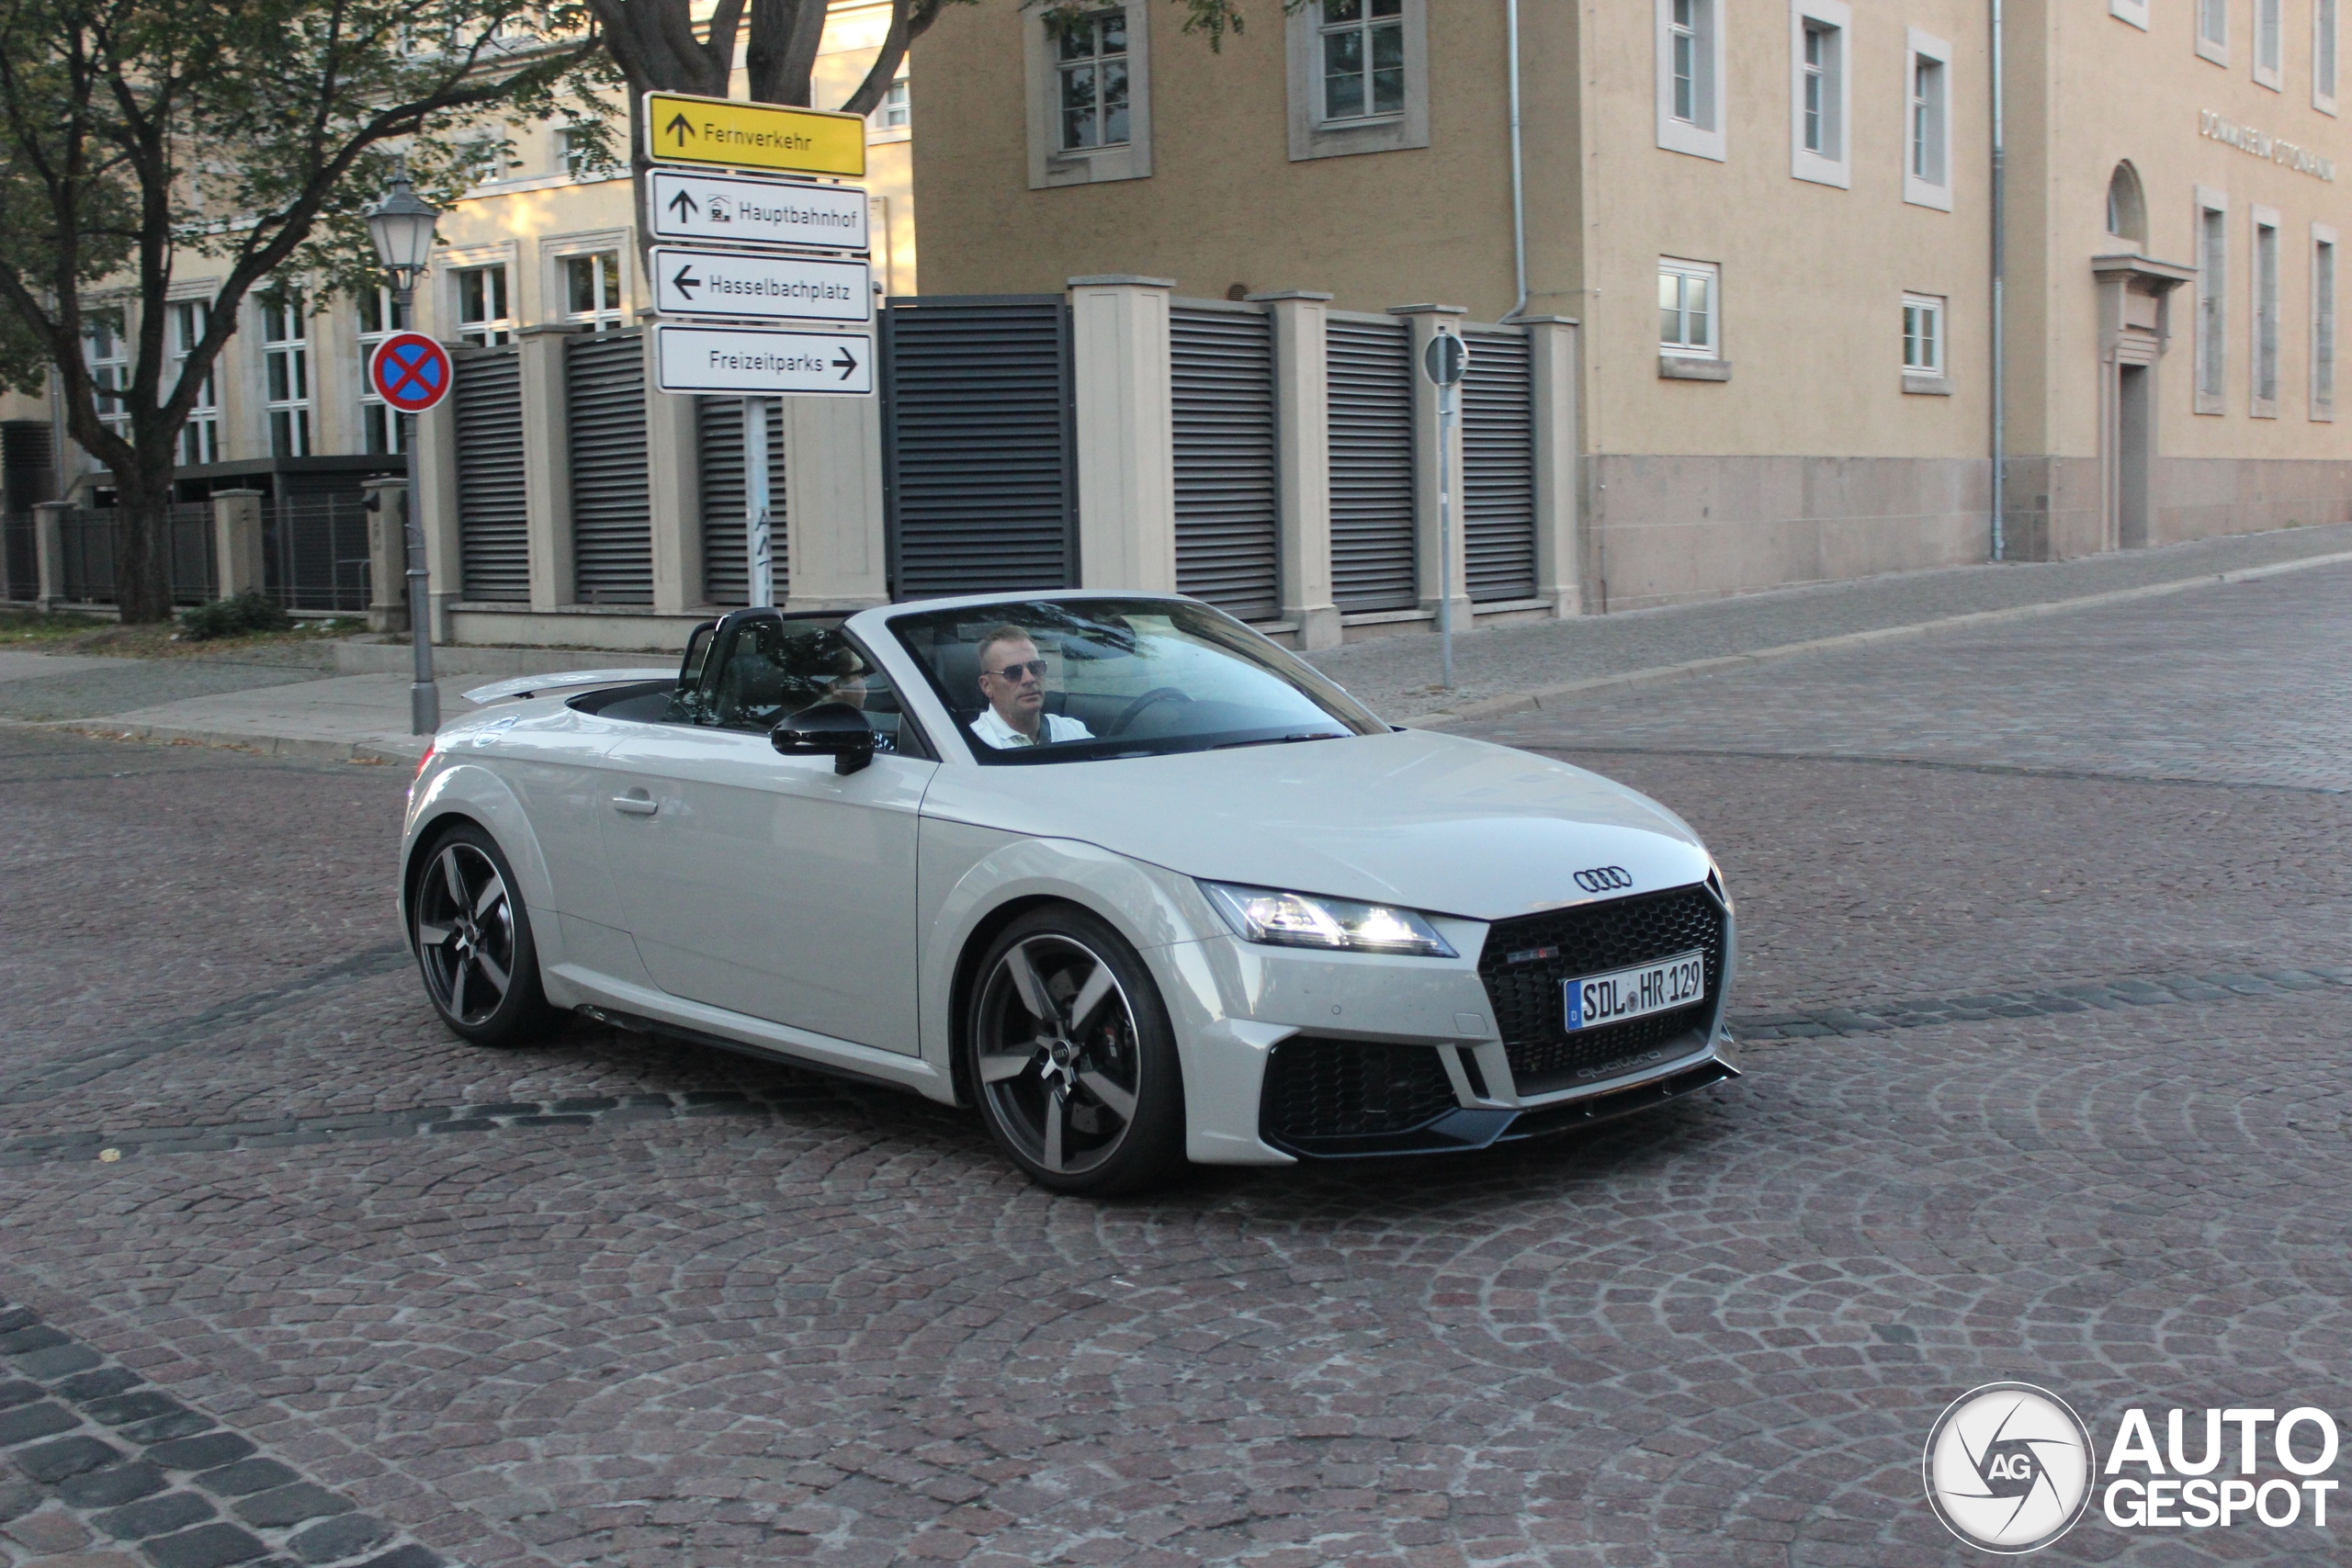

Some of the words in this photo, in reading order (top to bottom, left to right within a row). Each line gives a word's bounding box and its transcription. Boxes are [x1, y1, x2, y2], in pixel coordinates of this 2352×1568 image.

[704, 123, 813, 152] Fernverkehr
[739, 201, 858, 229] Hauptbahnhof
[709, 275, 851, 303] Hasselbachplatz
[709, 350, 824, 375] Freizeitparks
[1583, 979, 1625, 1021] SDL
[1640, 970, 1664, 1010] HR
[1669, 960, 1700, 1002] 129
[1571, 1010, 1577, 1021] D
[1576, 1050, 1662, 1078] quattro
